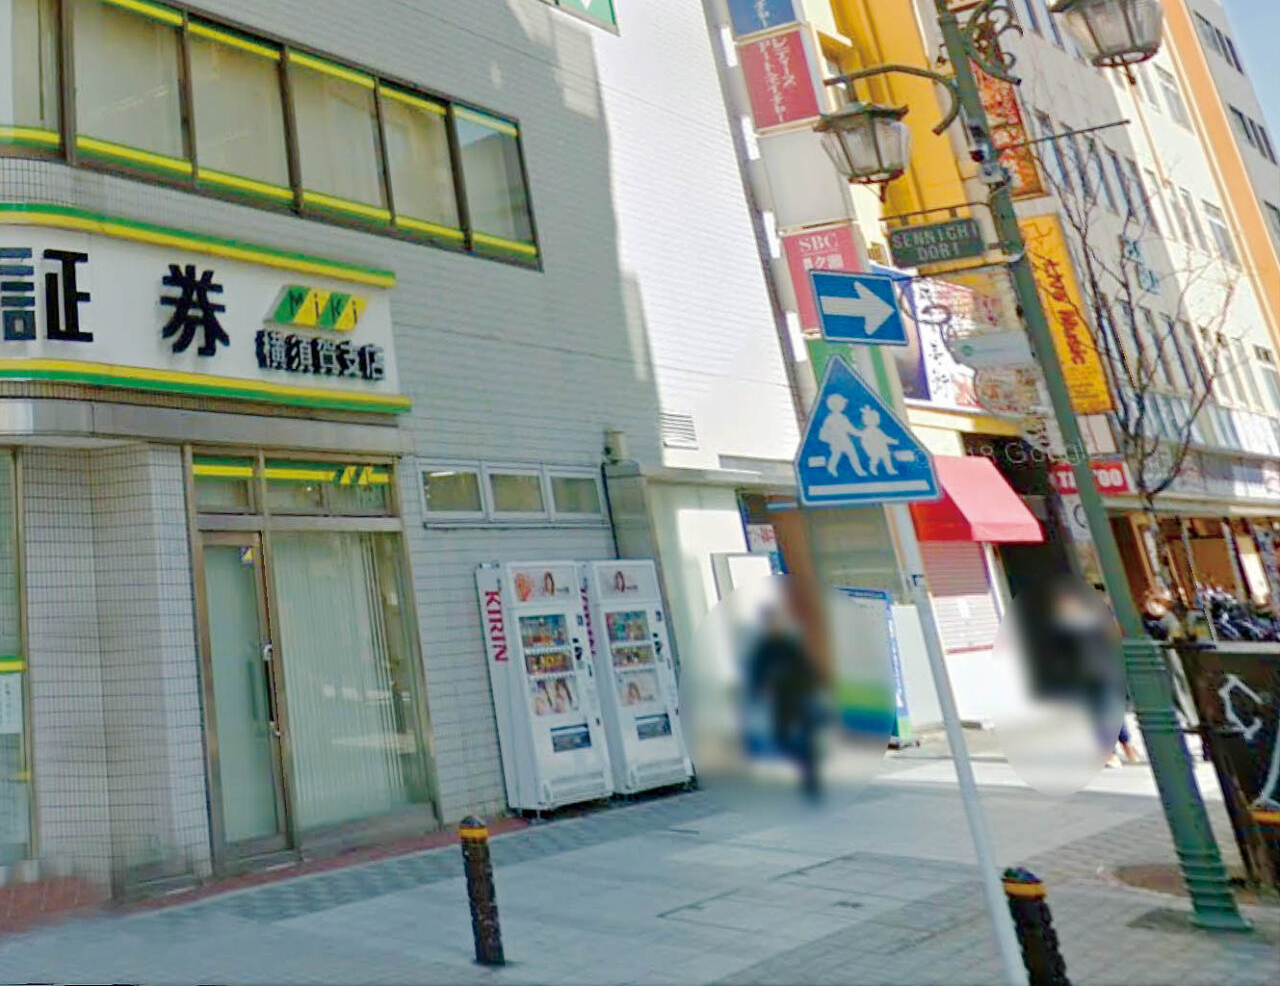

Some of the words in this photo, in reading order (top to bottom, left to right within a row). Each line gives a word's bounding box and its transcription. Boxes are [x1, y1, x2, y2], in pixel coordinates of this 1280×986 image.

[798, 232, 838, 253] SBC
[256, 329, 385, 381] 横須賀支店
[485, 590, 508, 662] KIRIN
